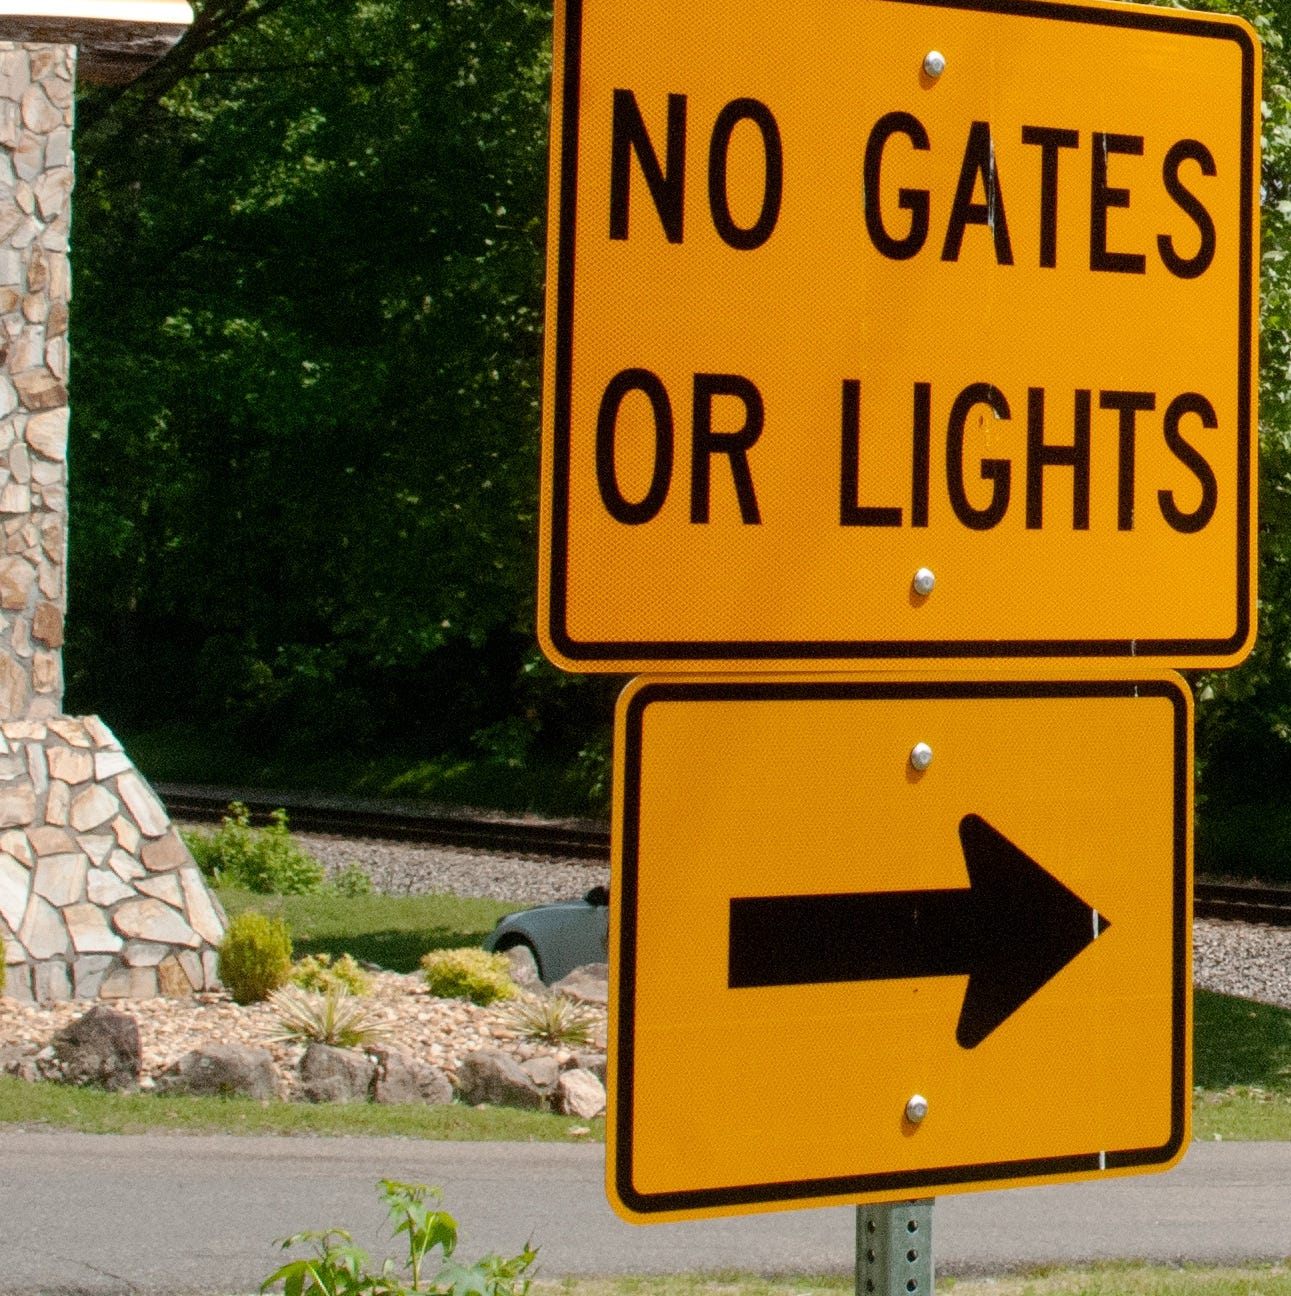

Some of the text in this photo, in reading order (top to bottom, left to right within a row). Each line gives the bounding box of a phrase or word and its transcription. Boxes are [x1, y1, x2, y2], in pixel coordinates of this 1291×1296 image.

[608, 88, 1218, 280] NO GATES
[594, 367, 1220, 534] OR LIGHTS
